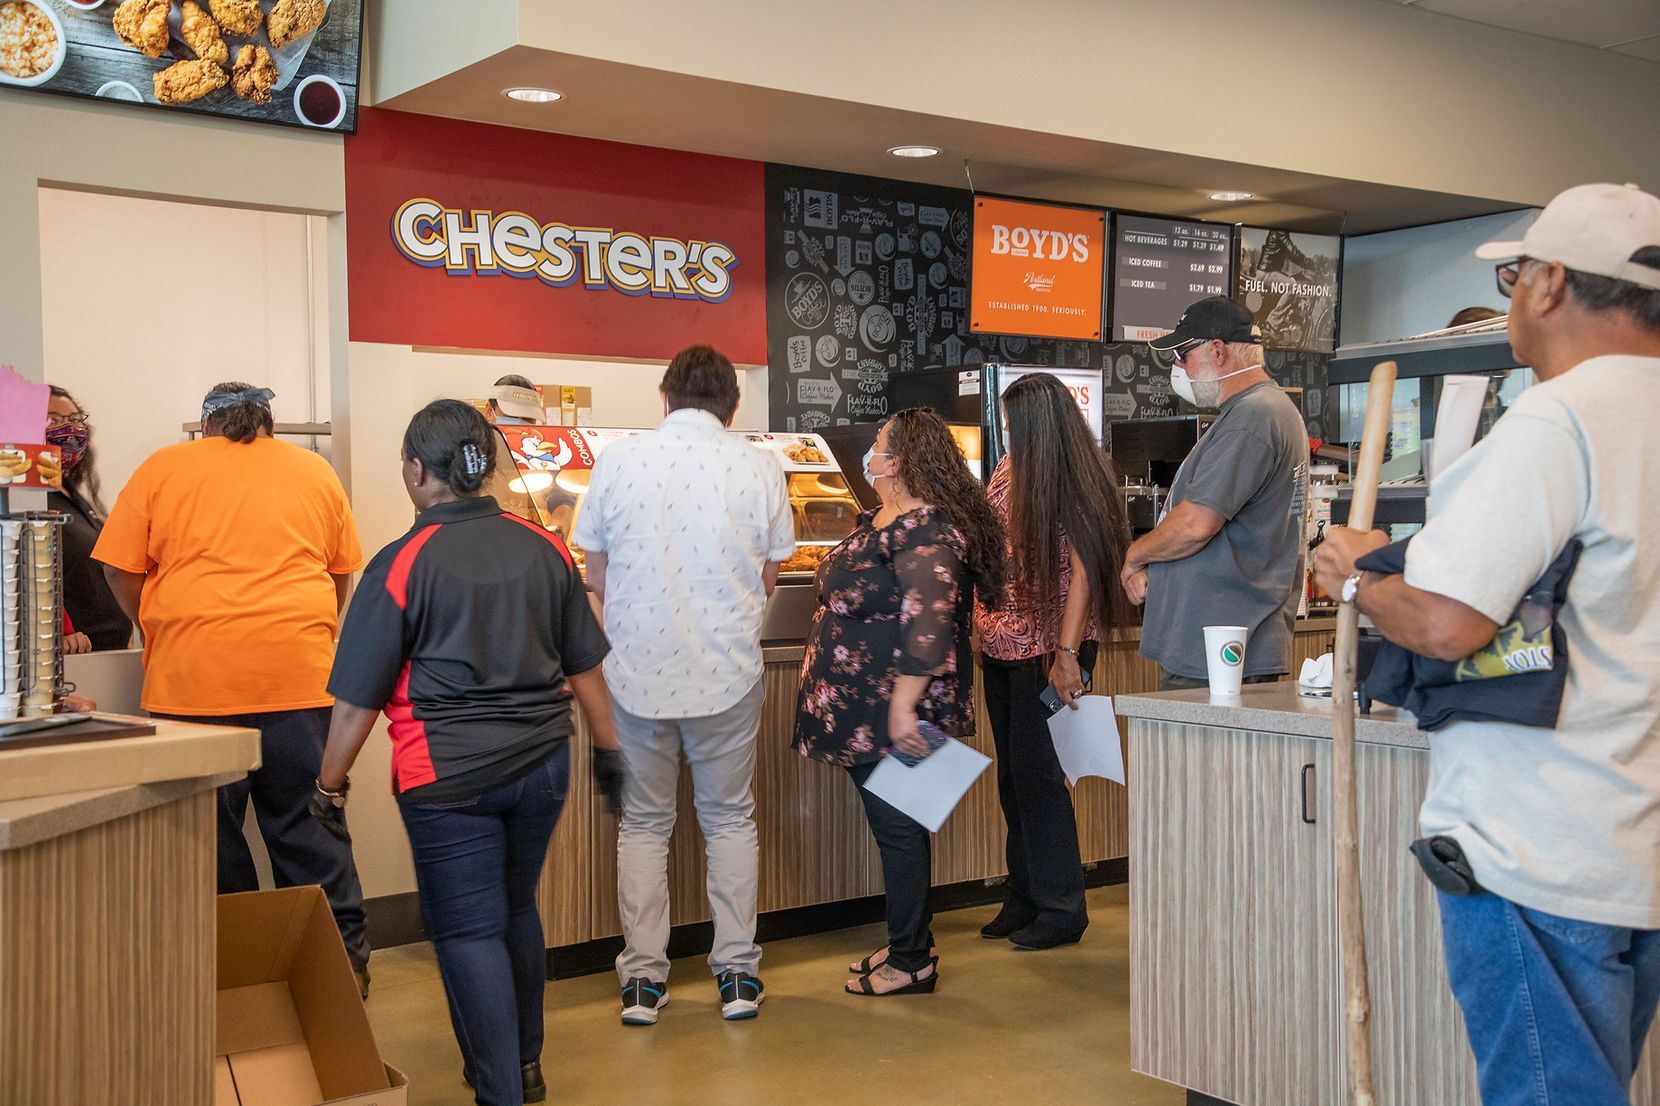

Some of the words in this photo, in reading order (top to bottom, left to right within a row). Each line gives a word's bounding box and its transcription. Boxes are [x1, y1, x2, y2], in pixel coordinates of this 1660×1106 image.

[1174, 226, 1181, 234] 12
[991, 224, 1089, 263] BOYD'S
[1124, 234, 1136, 243] HOT
[1137, 236, 1168, 246] BEVERAGES
[1128, 257, 1141, 266] ICED
[1142, 258, 1162, 268] COFFEE
[1131, 280, 1144, 288] ICED
[1144, 280, 1155, 289] TEA
[1245, 280, 1268, 293] FUEL.
[1270, 281, 1290, 294] NOT
[1292, 283, 1332, 297] FASHION.
[988, 300, 1030, 312] ESTABLISHED
[567, 428, 592, 466] COMBOS
